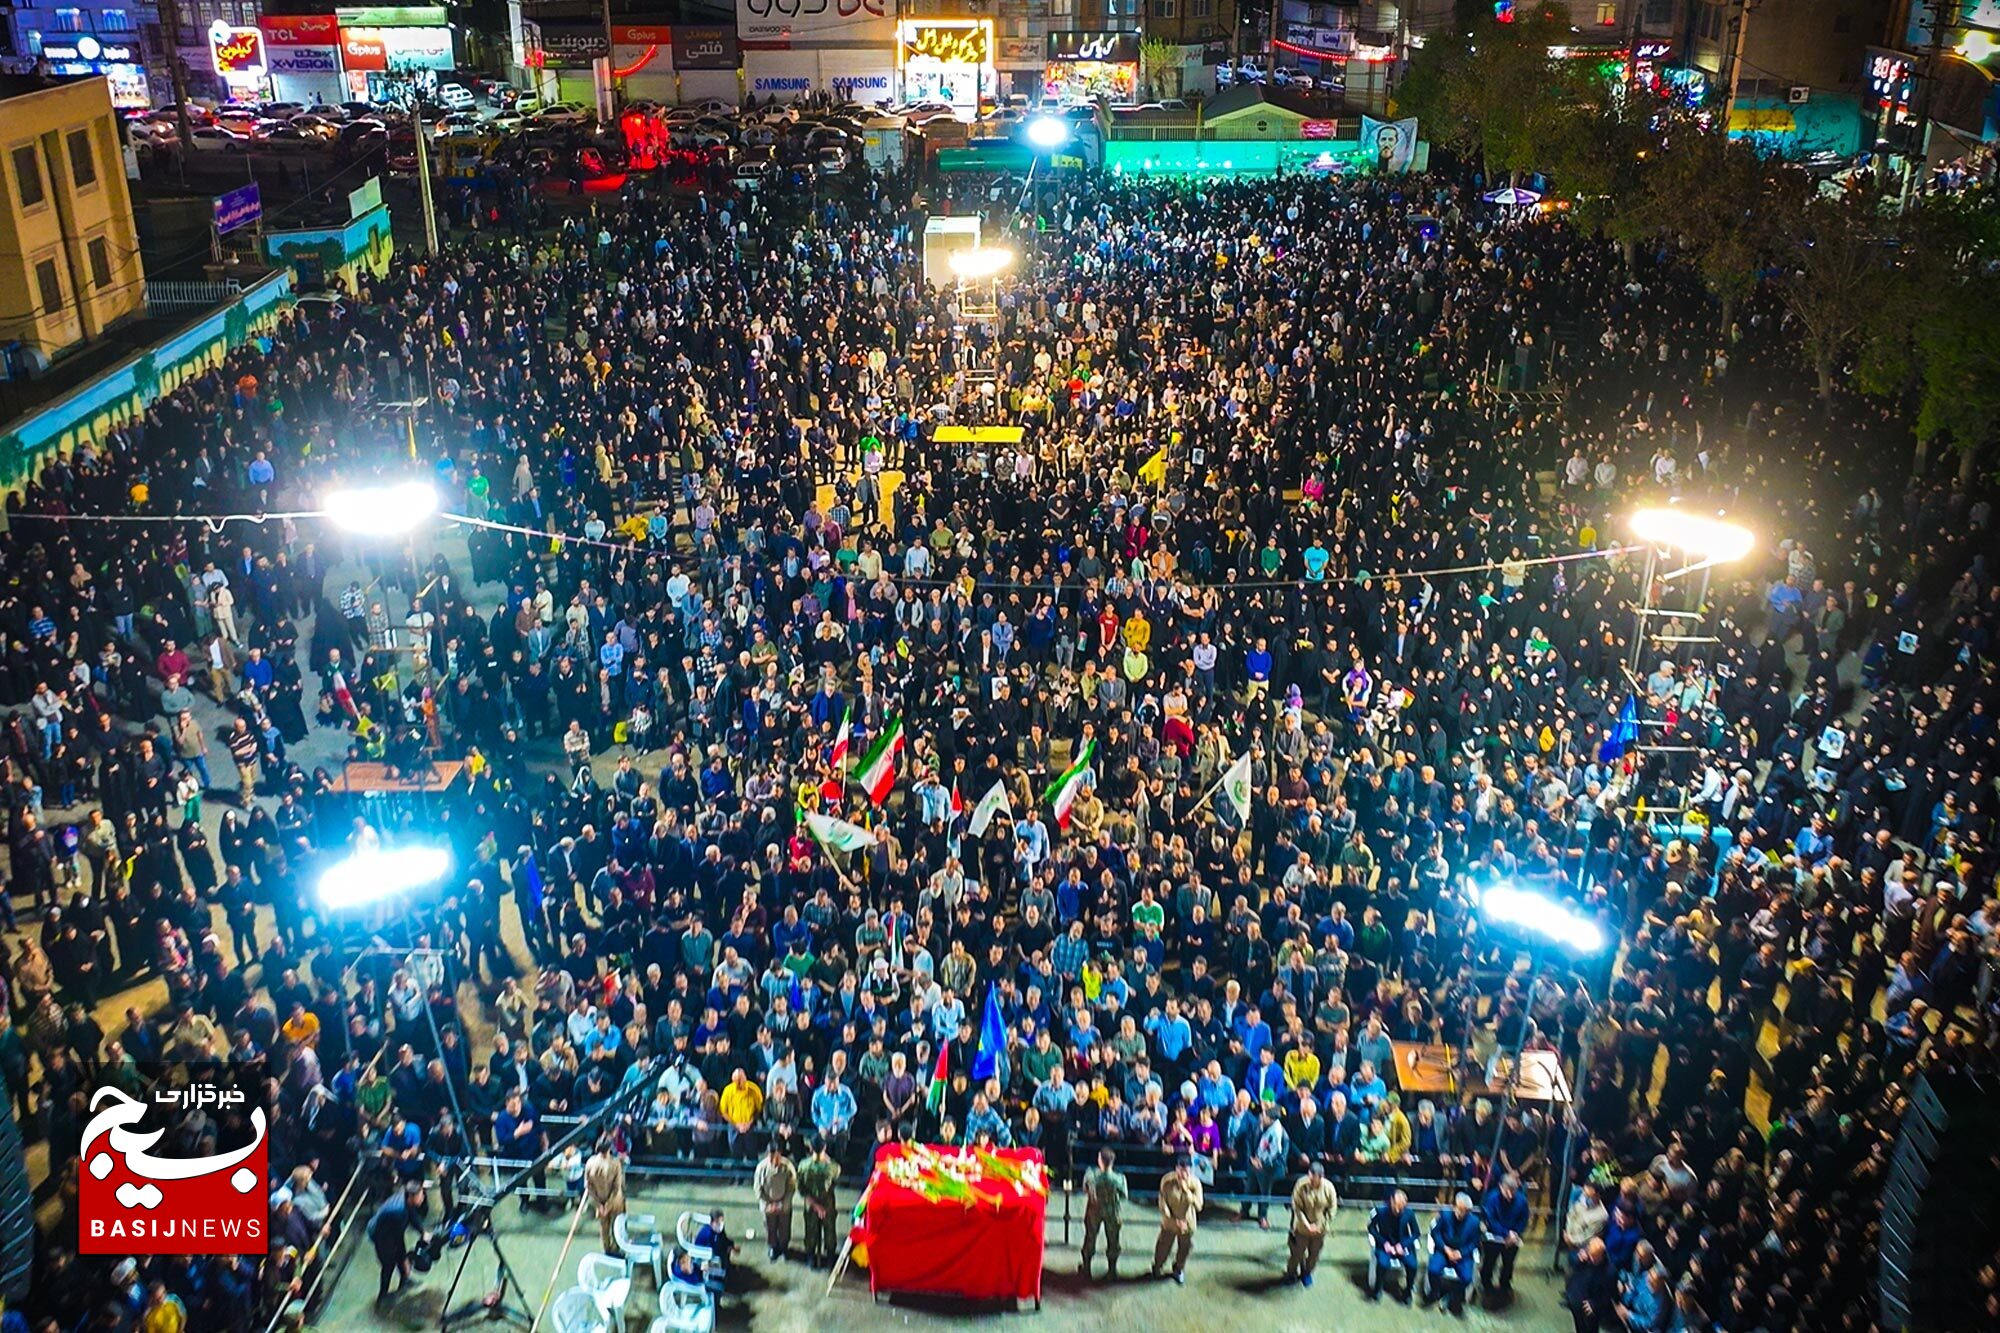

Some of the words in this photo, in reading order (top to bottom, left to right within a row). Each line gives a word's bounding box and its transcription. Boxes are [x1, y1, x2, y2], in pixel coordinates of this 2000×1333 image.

[268, 29, 297, 41] TCL
[627, 28, 657, 41] Gplus
[347, 42, 381, 56] Gplus
[686, 41, 723, 59] فتحی
[755, 77, 811, 90] SAMSUNG
[832, 77, 888, 89] SAMSUNG
